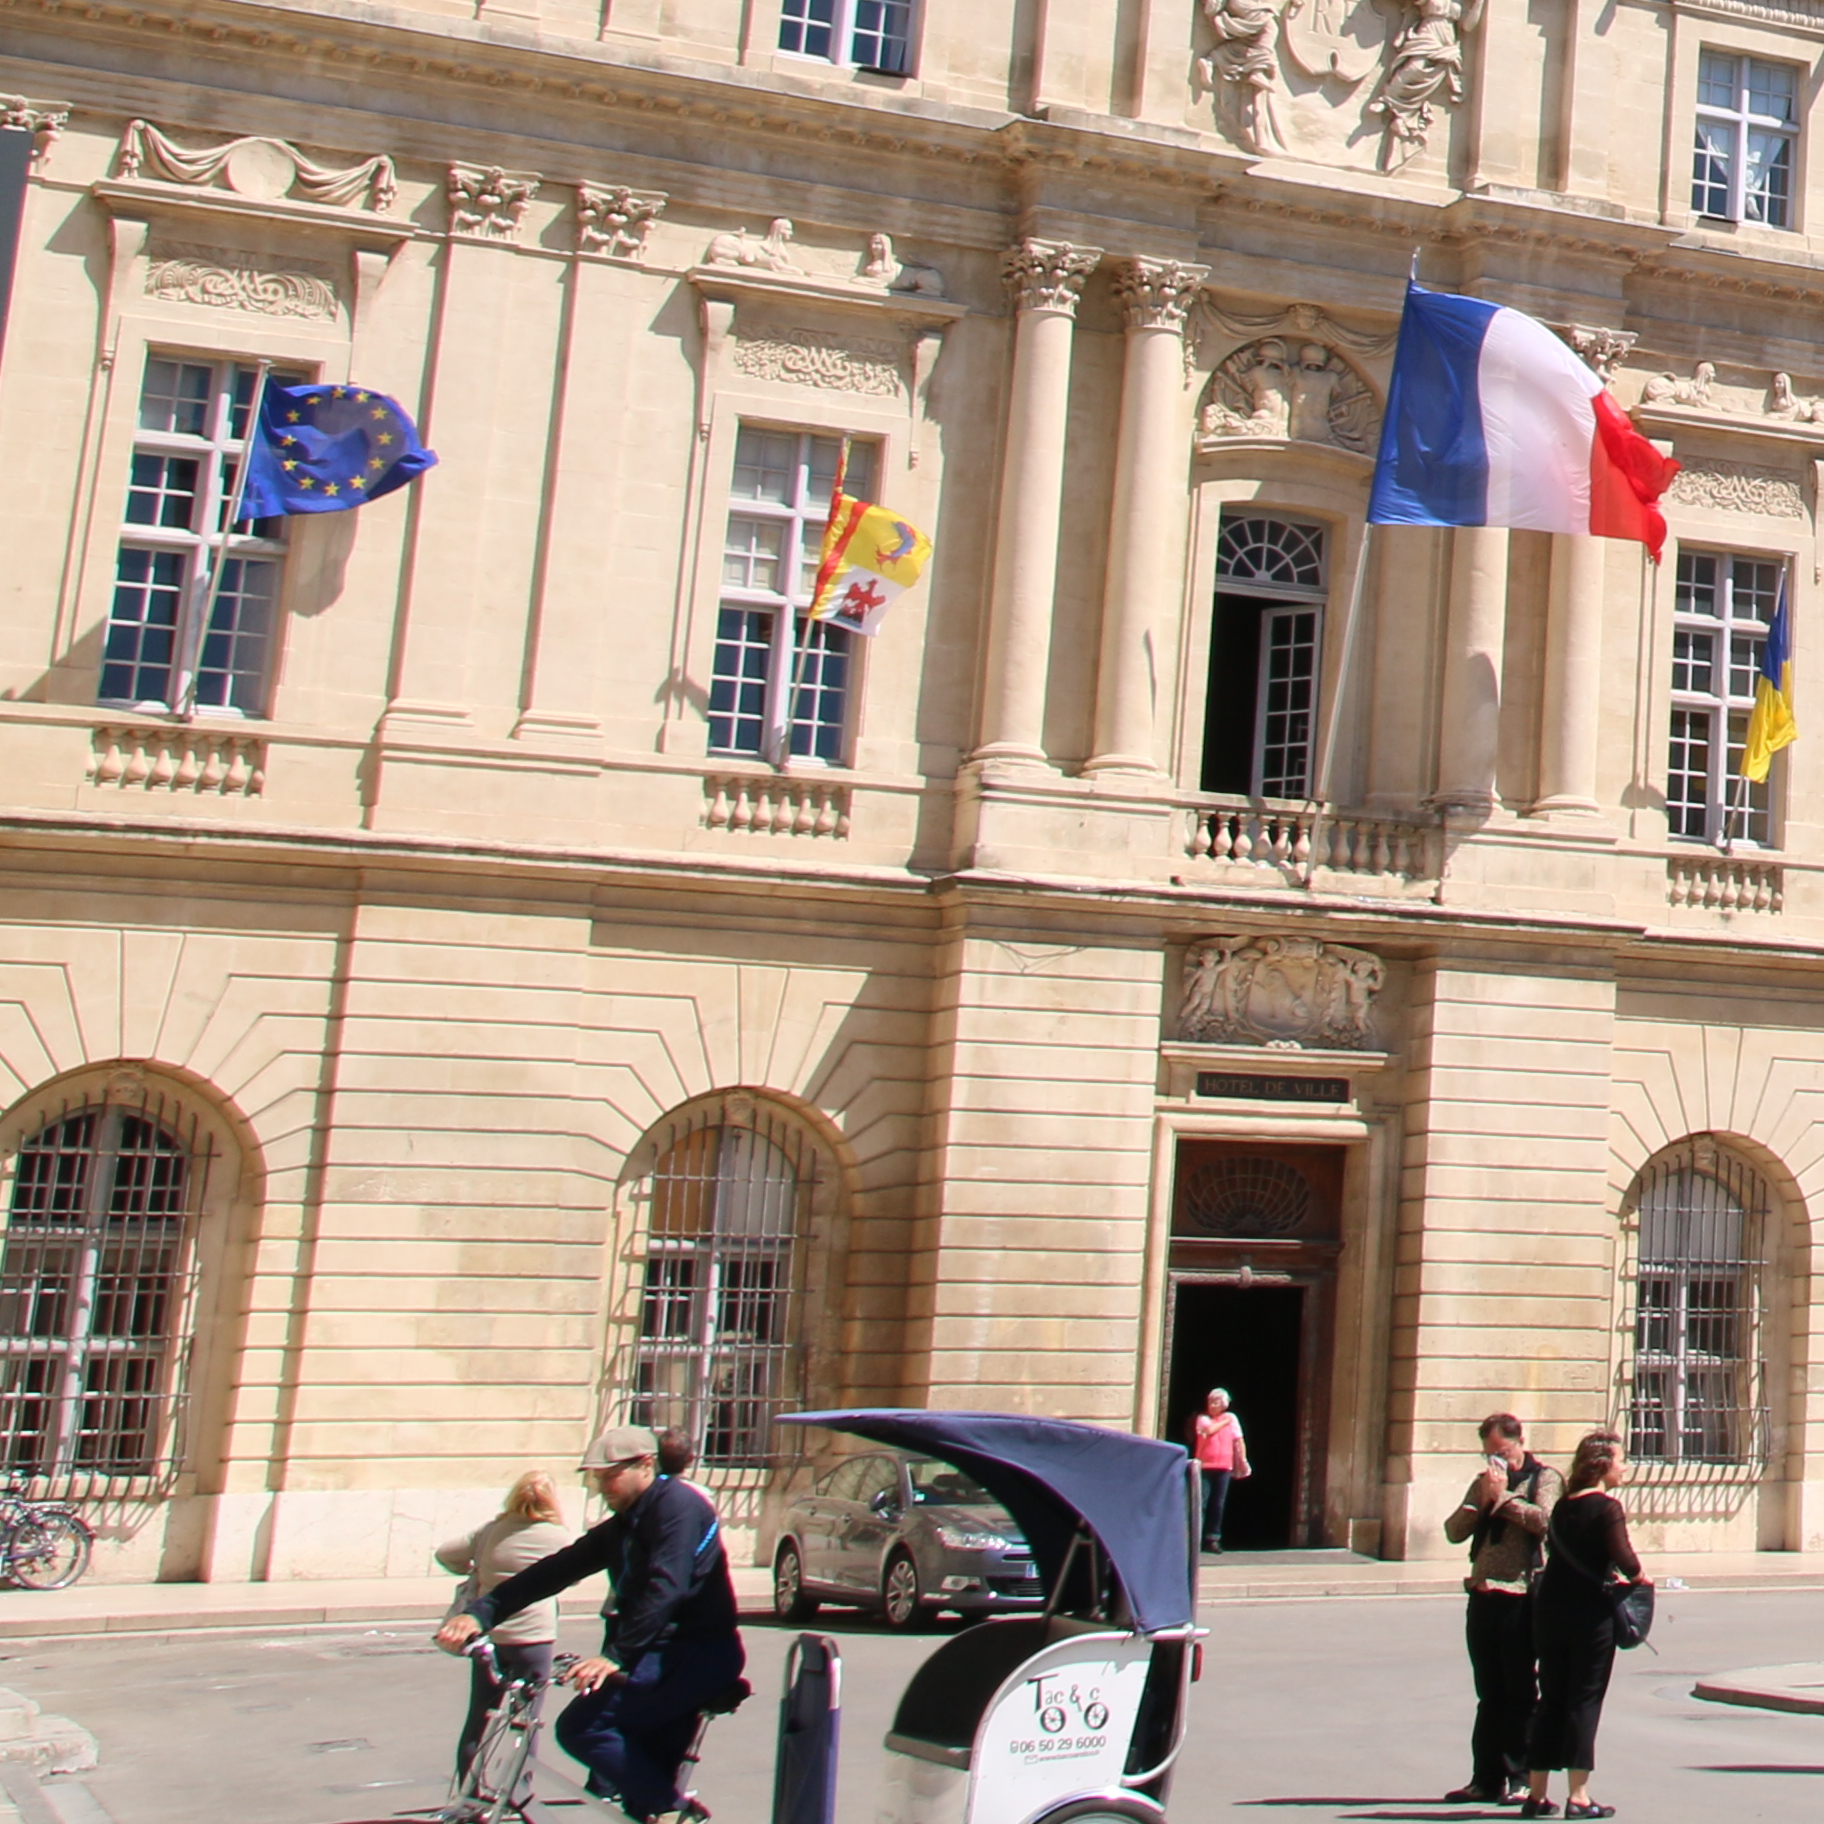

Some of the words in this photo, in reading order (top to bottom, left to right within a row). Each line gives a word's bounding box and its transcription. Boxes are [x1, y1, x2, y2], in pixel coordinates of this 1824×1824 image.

[1265, 1081, 1288, 1095] DE
[1295, 1083, 1342, 1097] VILLE
[1019, 1740, 1035, 1754] 06
[1038, 1738, 1055, 1752] 50
[1056, 1737, 1073, 1751] 29
[1075, 1735, 1107, 1749] 6000
